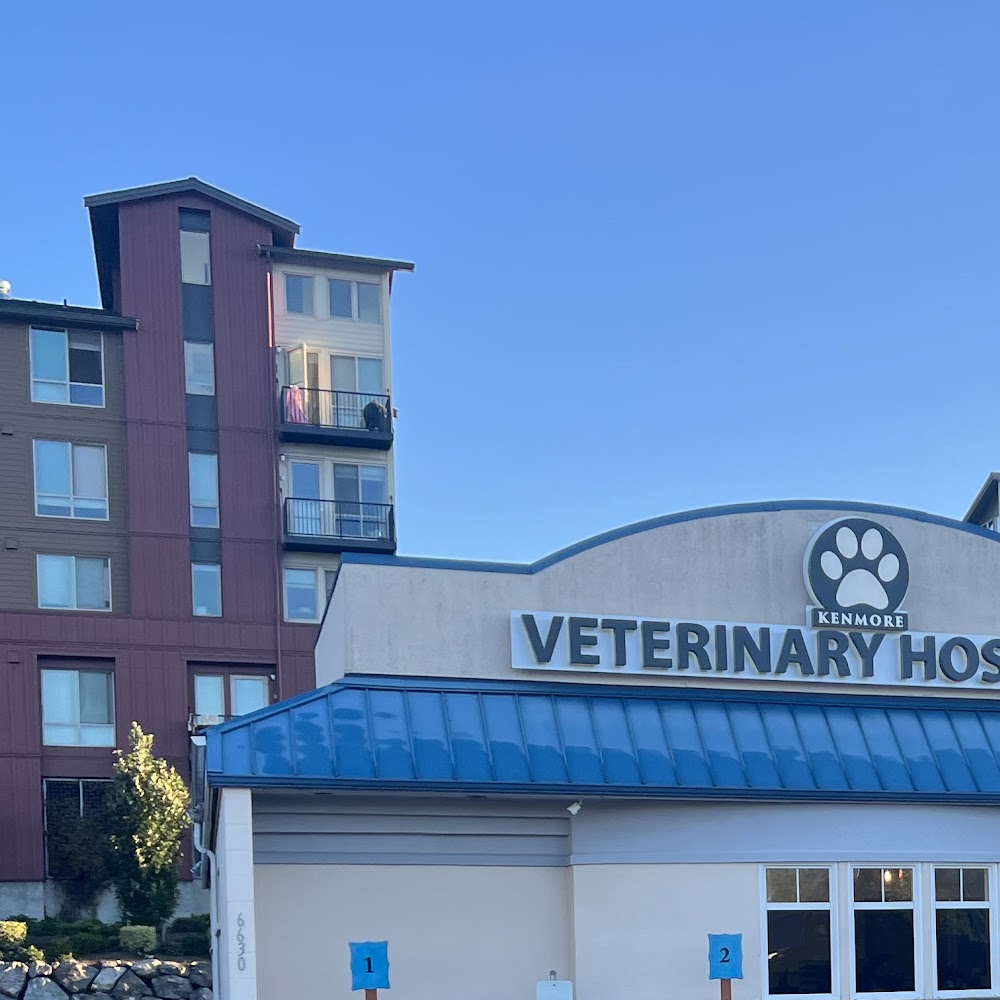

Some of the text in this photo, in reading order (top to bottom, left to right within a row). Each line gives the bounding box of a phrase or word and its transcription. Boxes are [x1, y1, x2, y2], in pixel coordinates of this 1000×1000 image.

[818, 611, 904, 628] KENMORE
[521, 614, 886, 678] VETERINARY
[236, 911, 246, 971] 6630
[719, 947, 730, 963] 2
[364, 956, 374, 973] 1
